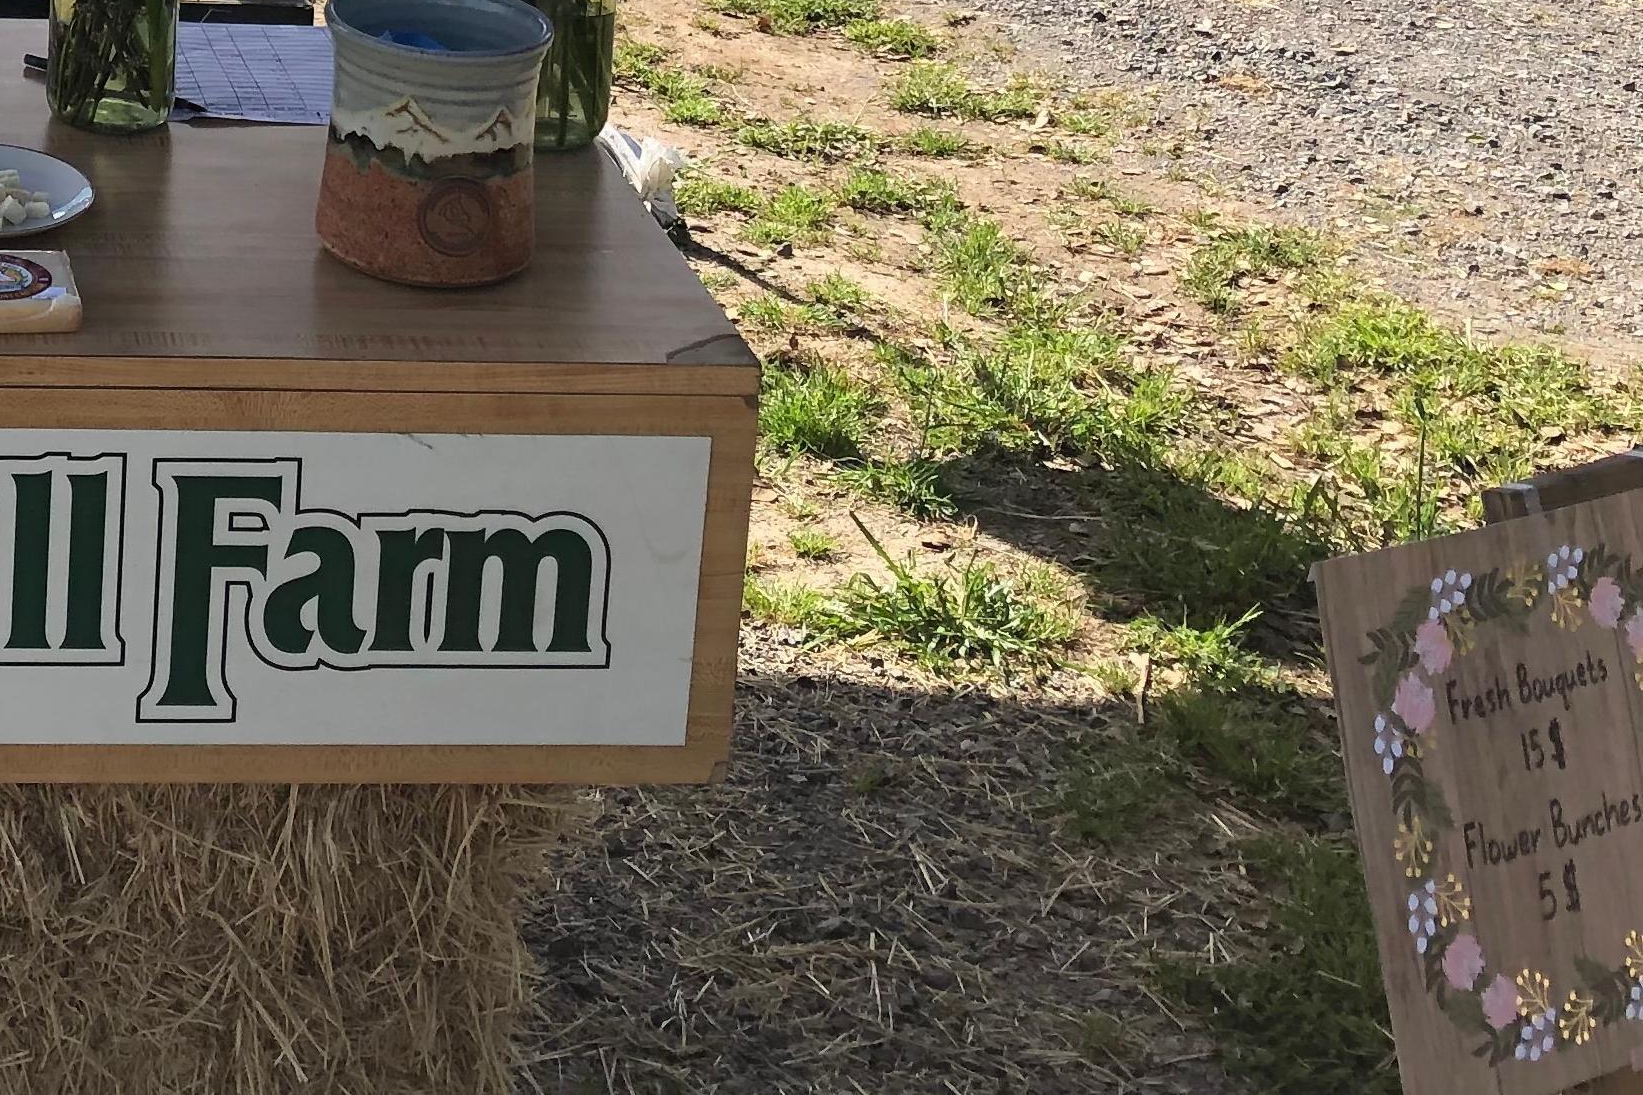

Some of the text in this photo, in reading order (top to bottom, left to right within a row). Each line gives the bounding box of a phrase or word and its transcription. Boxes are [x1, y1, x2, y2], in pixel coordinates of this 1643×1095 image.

[136, 457, 611, 723] Farm
[1445, 648, 1608, 725] Fresh Bouquets
[1463, 790, 1643, 869] Flower Bunches
